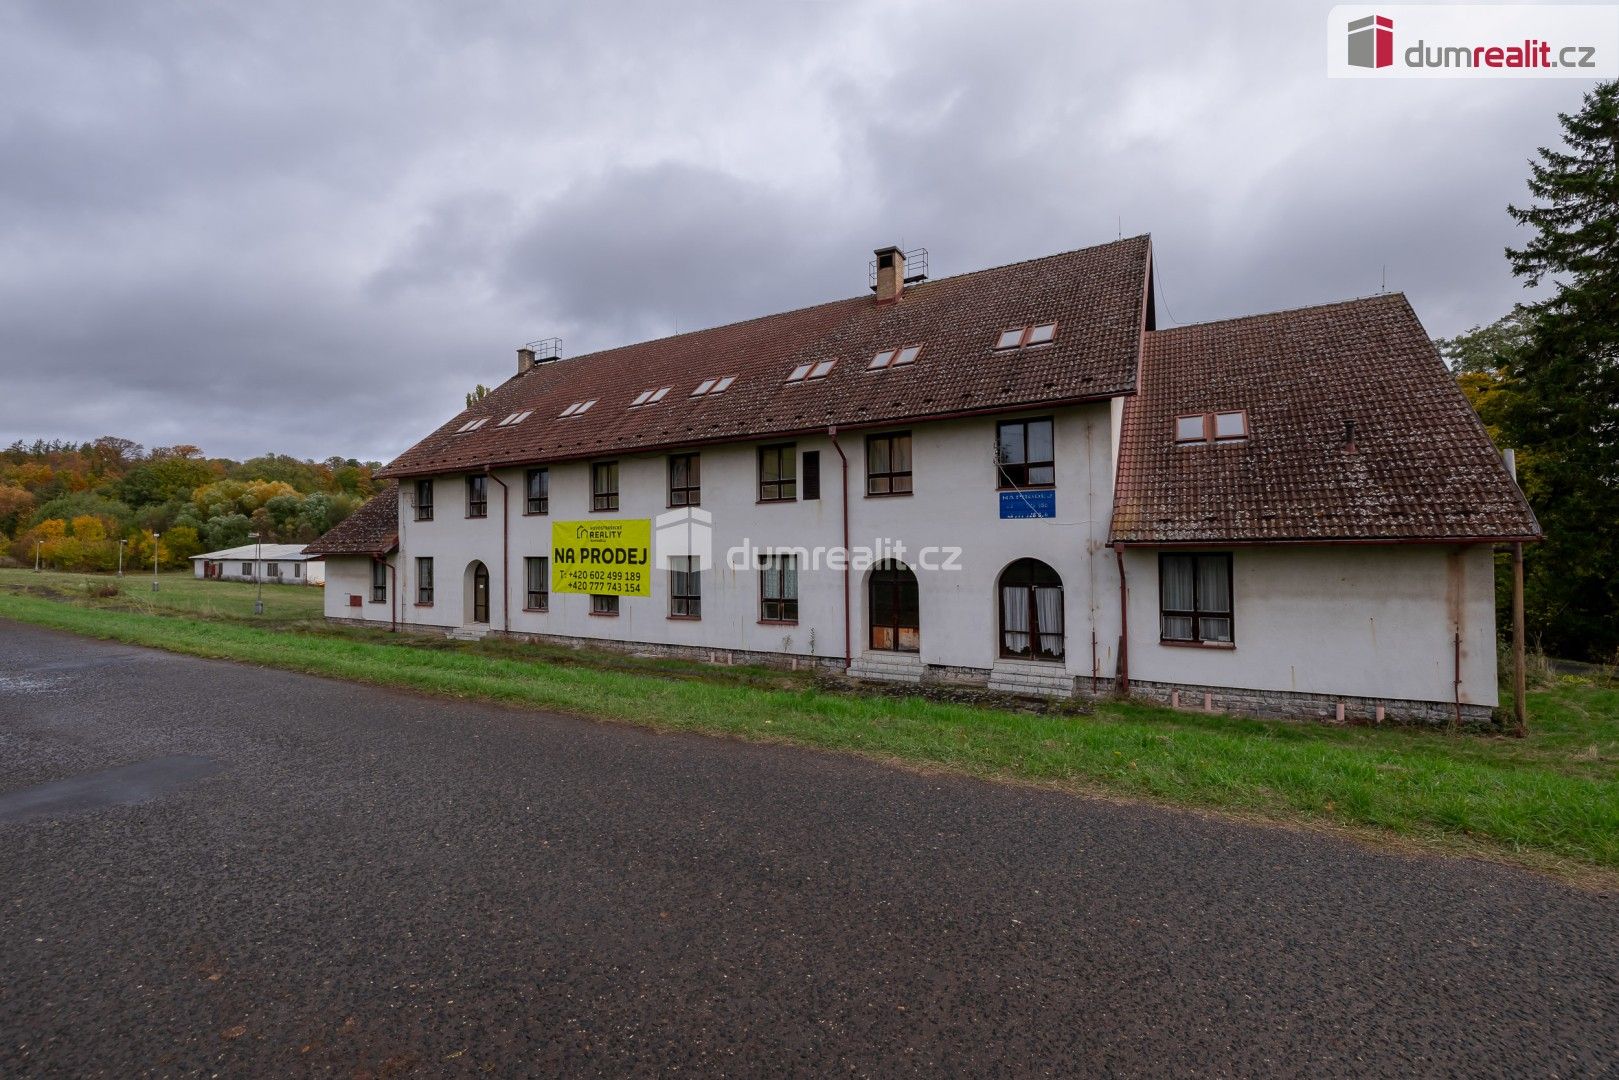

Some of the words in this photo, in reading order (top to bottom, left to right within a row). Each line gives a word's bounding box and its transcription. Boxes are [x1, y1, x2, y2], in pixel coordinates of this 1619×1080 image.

[554, 548, 575, 563] NA
[580, 548, 647, 564] PRODEJ
[569, 571, 588, 579] +420
[590, 571, 605, 580] 602
[607, 572, 622, 580] 499
[625, 572, 641, 581] 189
[568, 582, 587, 590] +420
[590, 582, 604, 590] 777
[607, 582, 622, 592] 743
[625, 583, 641, 592] 154
